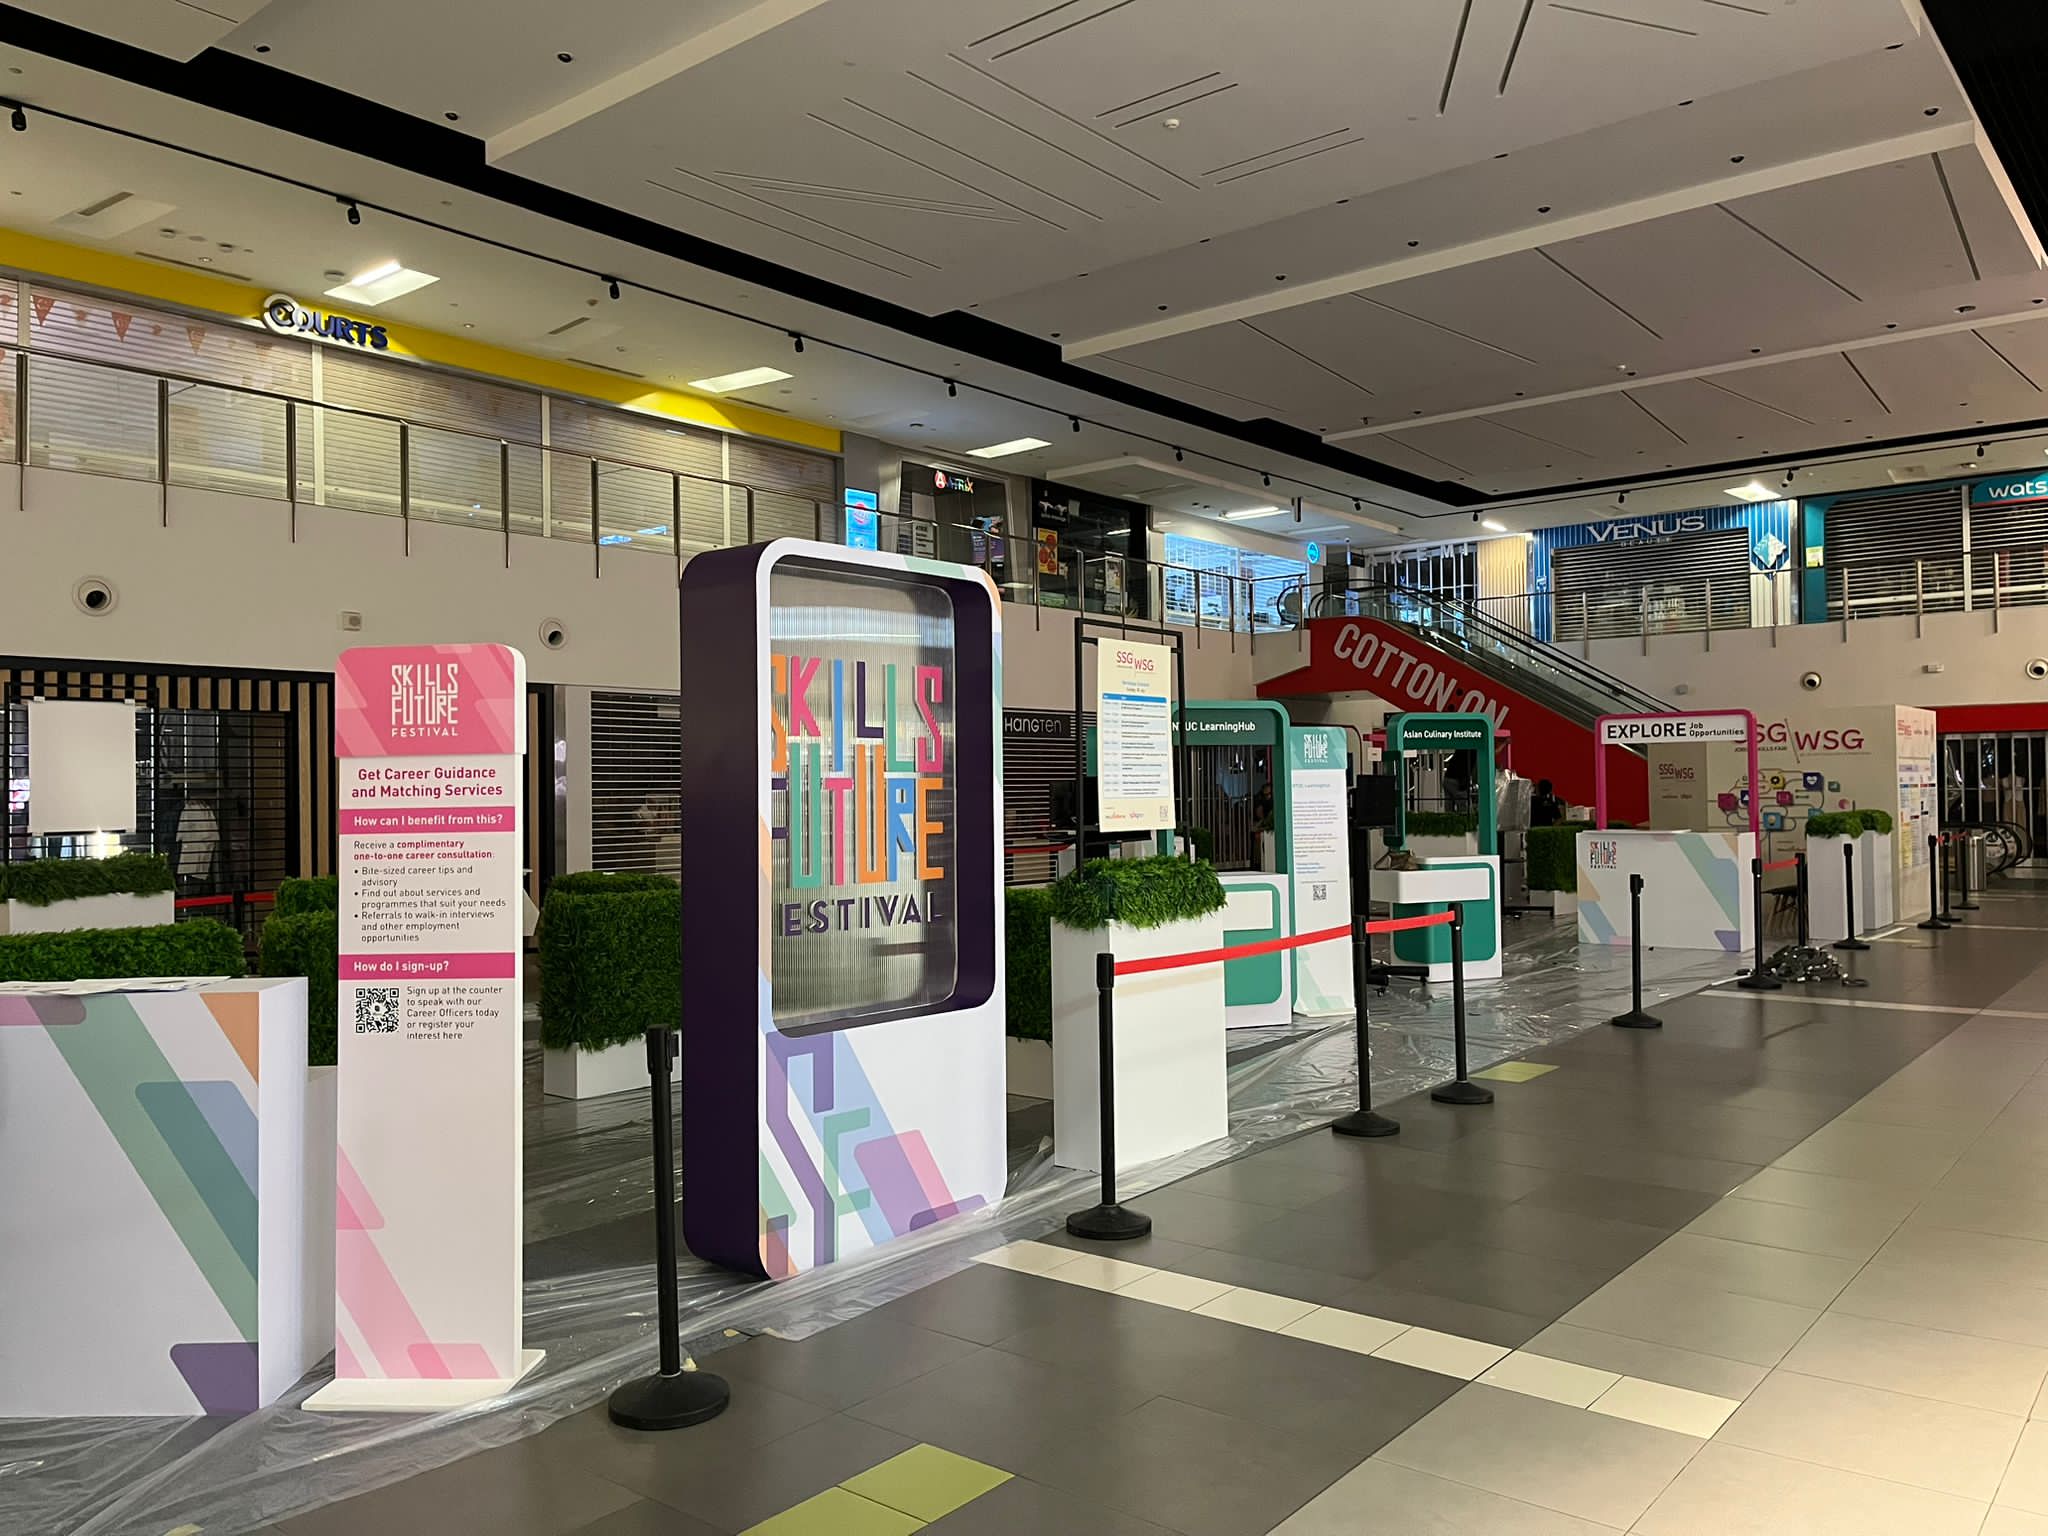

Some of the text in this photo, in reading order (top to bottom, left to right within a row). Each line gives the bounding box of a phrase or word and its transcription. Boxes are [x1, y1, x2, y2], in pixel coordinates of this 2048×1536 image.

[263, 294, 388, 349] COURTS
[1988, 481, 2048, 498] wats
[1586, 516, 1704, 542] VENUS
[1116, 650, 1133, 664] SSG
[1134, 658, 1154, 672] WSG
[392, 664, 458, 696] SKILLS
[392, 687, 458, 725] FUTURE
[392, 728, 458, 738] FESTIVAL
[1172, 721, 1256, 733] NUC LearningHub
[1607, 722, 1687, 739] EXPLORE
[1690, 728, 1744, 738] Opportunities
[1403, 730, 1482, 740] Asian Culinary Institute
[1794, 729, 1865, 750] WSG
[358, 766, 496, 780] Get Career Guidance
[1658, 764, 1674, 776] SSG
[1674, 767, 1694, 780] WSG
[352, 784, 502, 799] and Matching Services
[354, 814, 503, 826] How can I benefit from this?
[772, 743, 944, 889] UTURE
[354, 840, 387, 850] Receive
[396, 840, 464, 850] complimentary
[354, 852, 404, 860] one-to-one
[406, 852, 434, 860] career
[362, 866, 406, 876] Bite-sized
[438, 866, 454, 876] tips
[456, 866, 473, 874] and
[362, 878, 398, 888] advisory
[362, 889, 381, 897] Find
[400, 888, 424, 896] about
[426, 888, 462, 896] services
[464, 888, 480, 896] and
[362, 898, 506, 910] programmes that suit your needs
[362, 911, 402, 920] Referrals
[415, 910, 448, 918] walk-in
[450, 910, 495, 918] interviews
[362, 922, 460, 932] and other employment
[362, 934, 420, 944] opportunities
[354, 960, 450, 974] How do I sign-up?
[406, 986, 502, 996] Sign up at the counter
[418, 998, 444, 1006] speak
[446, 998, 464, 1006] with
[406, 1008, 500, 1018] Career Officers today
[418, 1020, 452, 1030] register
[454, 1020, 474, 1030] your
[406, 1032, 463, 1040] interest here
